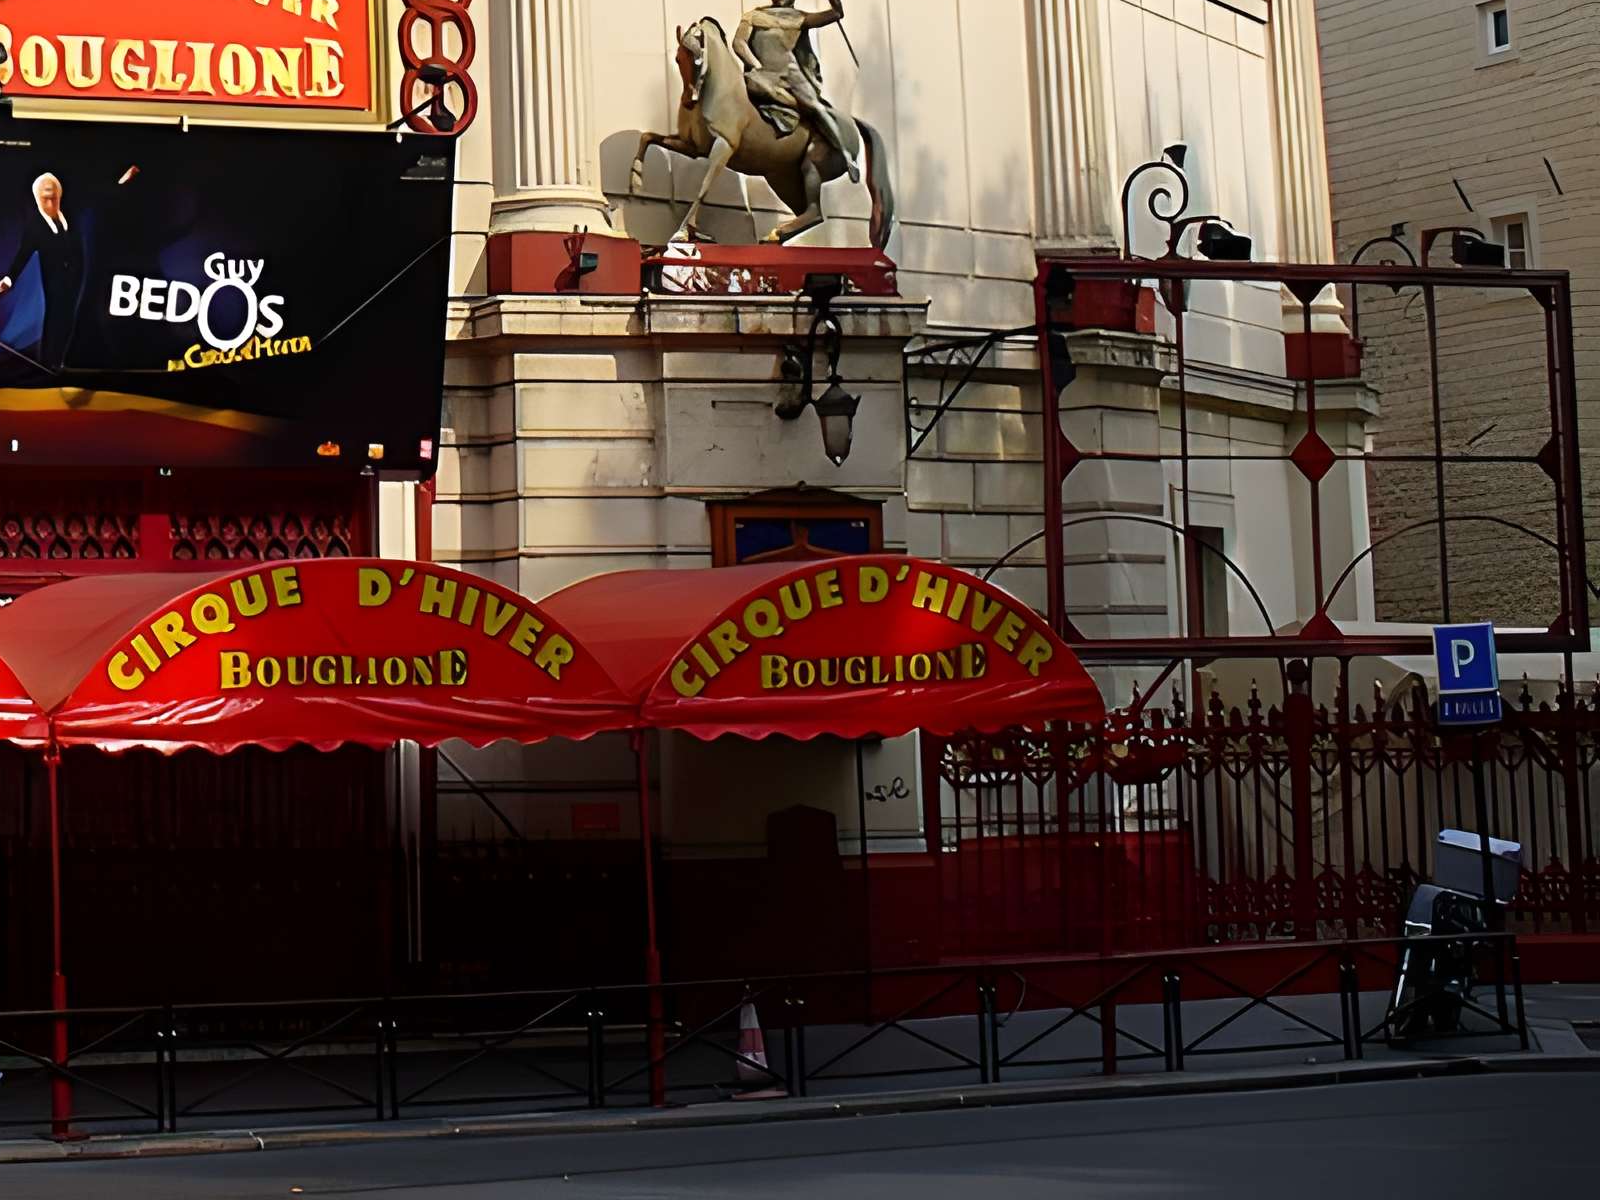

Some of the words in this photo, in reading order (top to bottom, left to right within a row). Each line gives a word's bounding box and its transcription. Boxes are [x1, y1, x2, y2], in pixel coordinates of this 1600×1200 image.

[203, 252, 264, 287] Guy
[109, 274, 285, 352] BEDOS
[107, 567, 301, 690] CIRQUE
[359, 568, 575, 680] D'HIVER
[671, 569, 843, 697] CIRQUE
[859, 565, 1053, 676] D'HIVER
[220, 649, 468, 689] BOUGLIONE
[761, 643, 986, 688] BOUGLIONE
[1451, 640, 1475, 678] P
